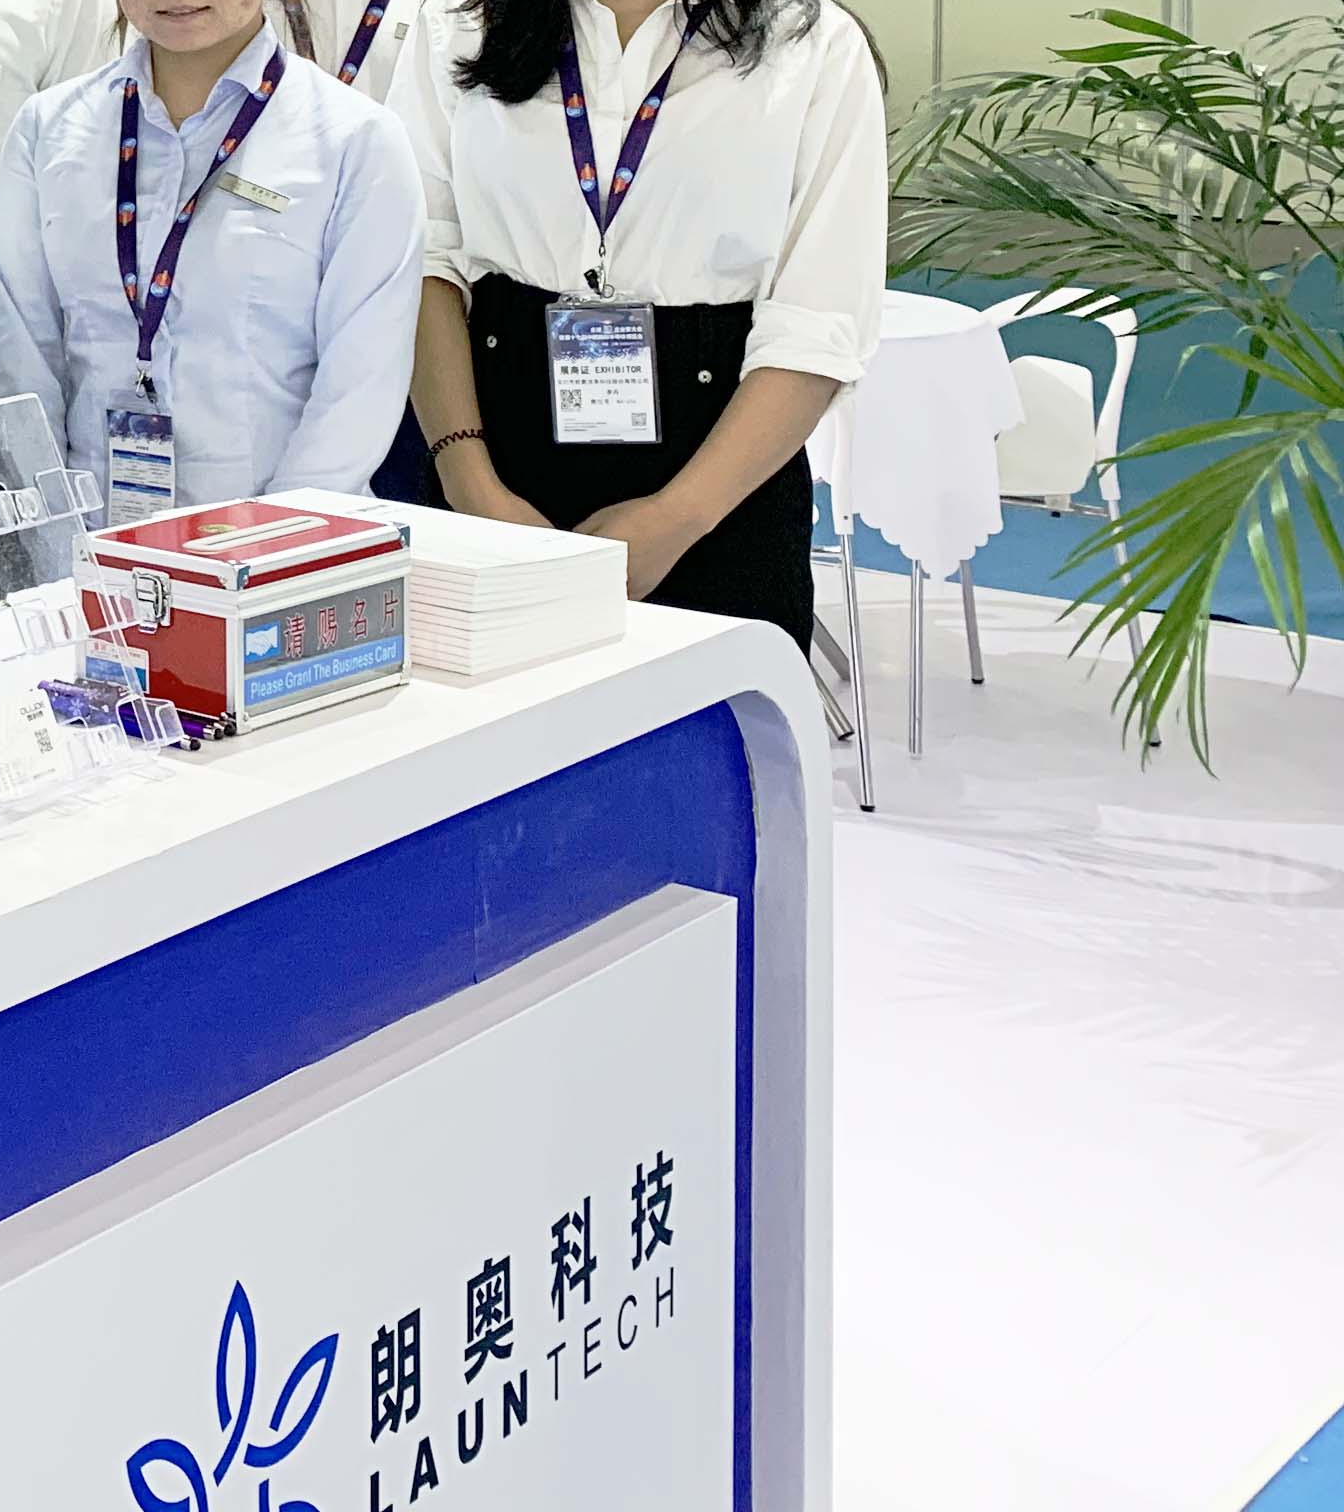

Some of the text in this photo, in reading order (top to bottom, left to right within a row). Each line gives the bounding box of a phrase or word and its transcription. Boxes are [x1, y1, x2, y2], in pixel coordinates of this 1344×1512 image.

[595, 365, 642, 374] EXHIBITOR
[283, 589, 400, 658] 请赐名片
[250, 642, 397, 700] Please Grant The Business Card
[370, 1150, 674, 1443] 朗奥科技
